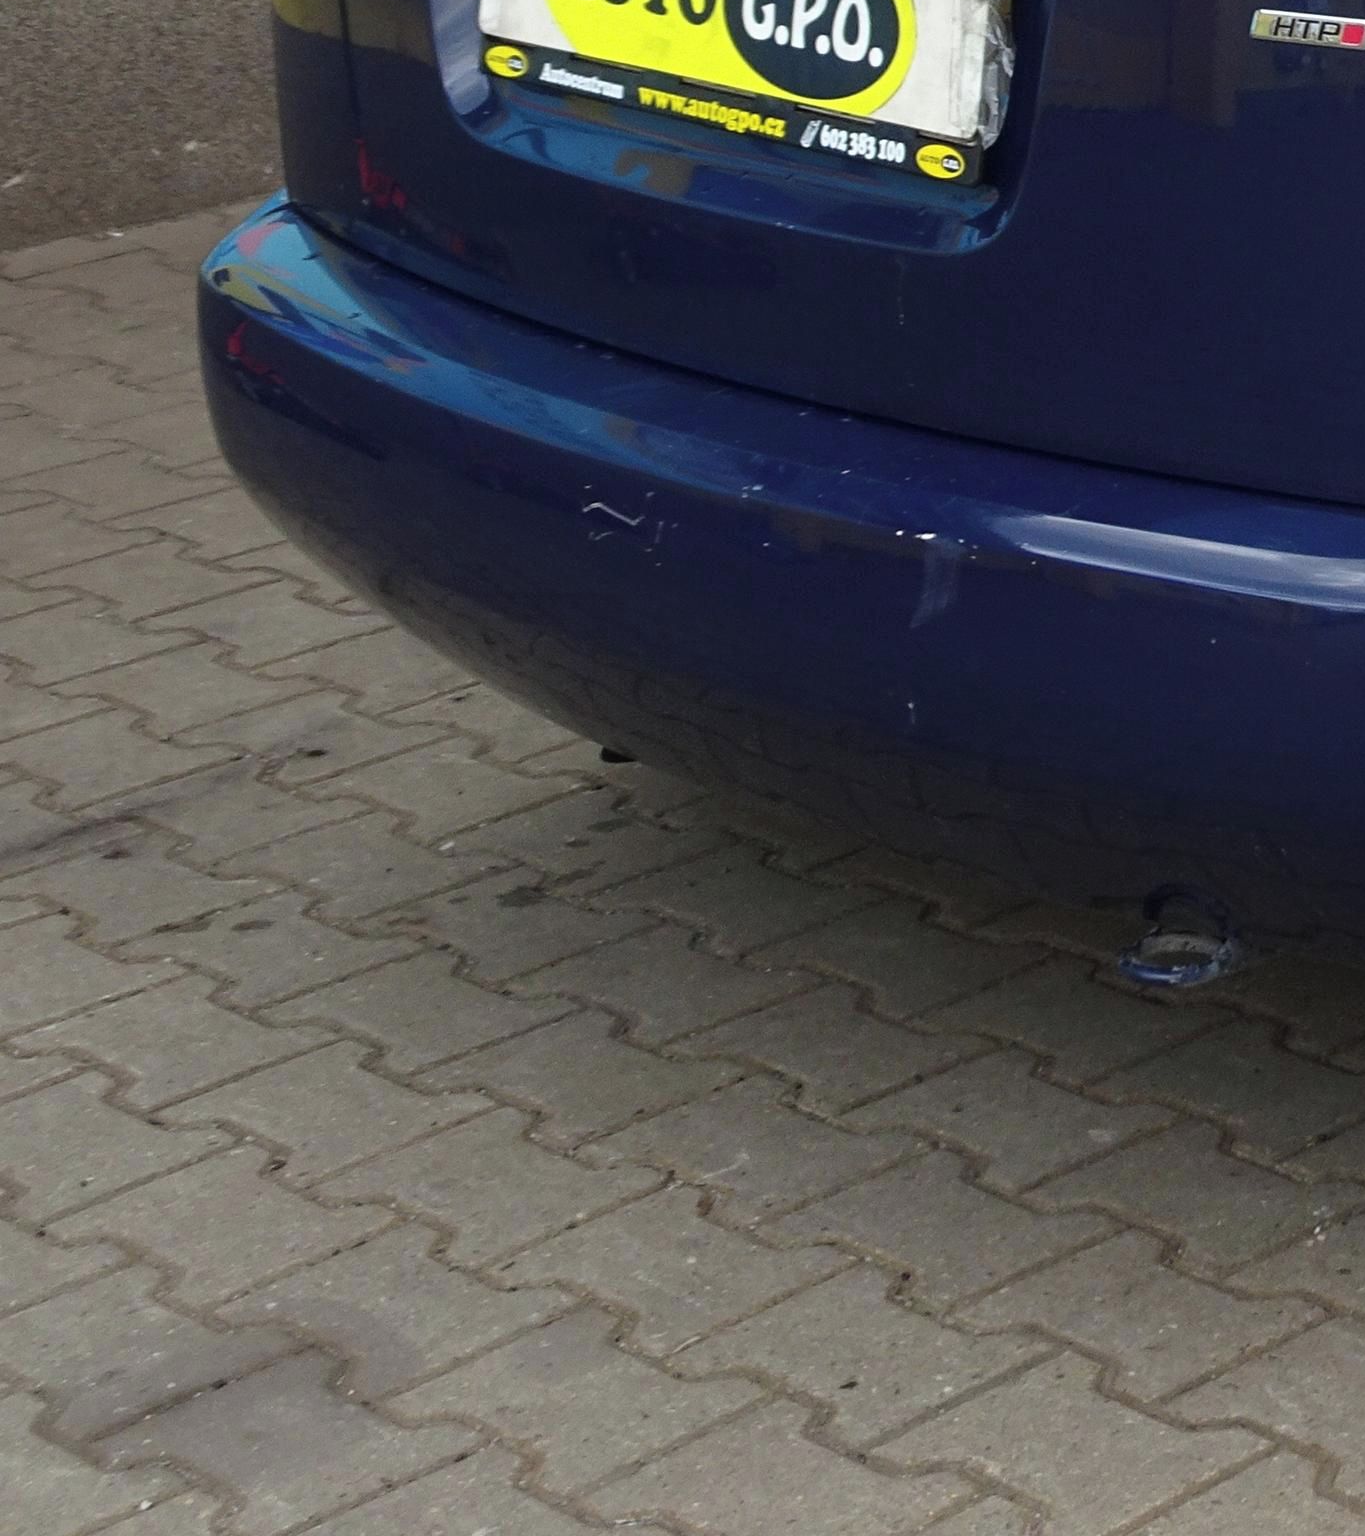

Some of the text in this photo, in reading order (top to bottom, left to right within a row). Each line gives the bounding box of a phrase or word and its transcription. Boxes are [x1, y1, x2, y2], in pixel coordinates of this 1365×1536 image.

[1273, 16, 1342, 42] HTP
[638, 86, 787, 138] www.autogpo.cz
[819, 123, 848, 152] 602
[877, 138, 906, 164] 100
